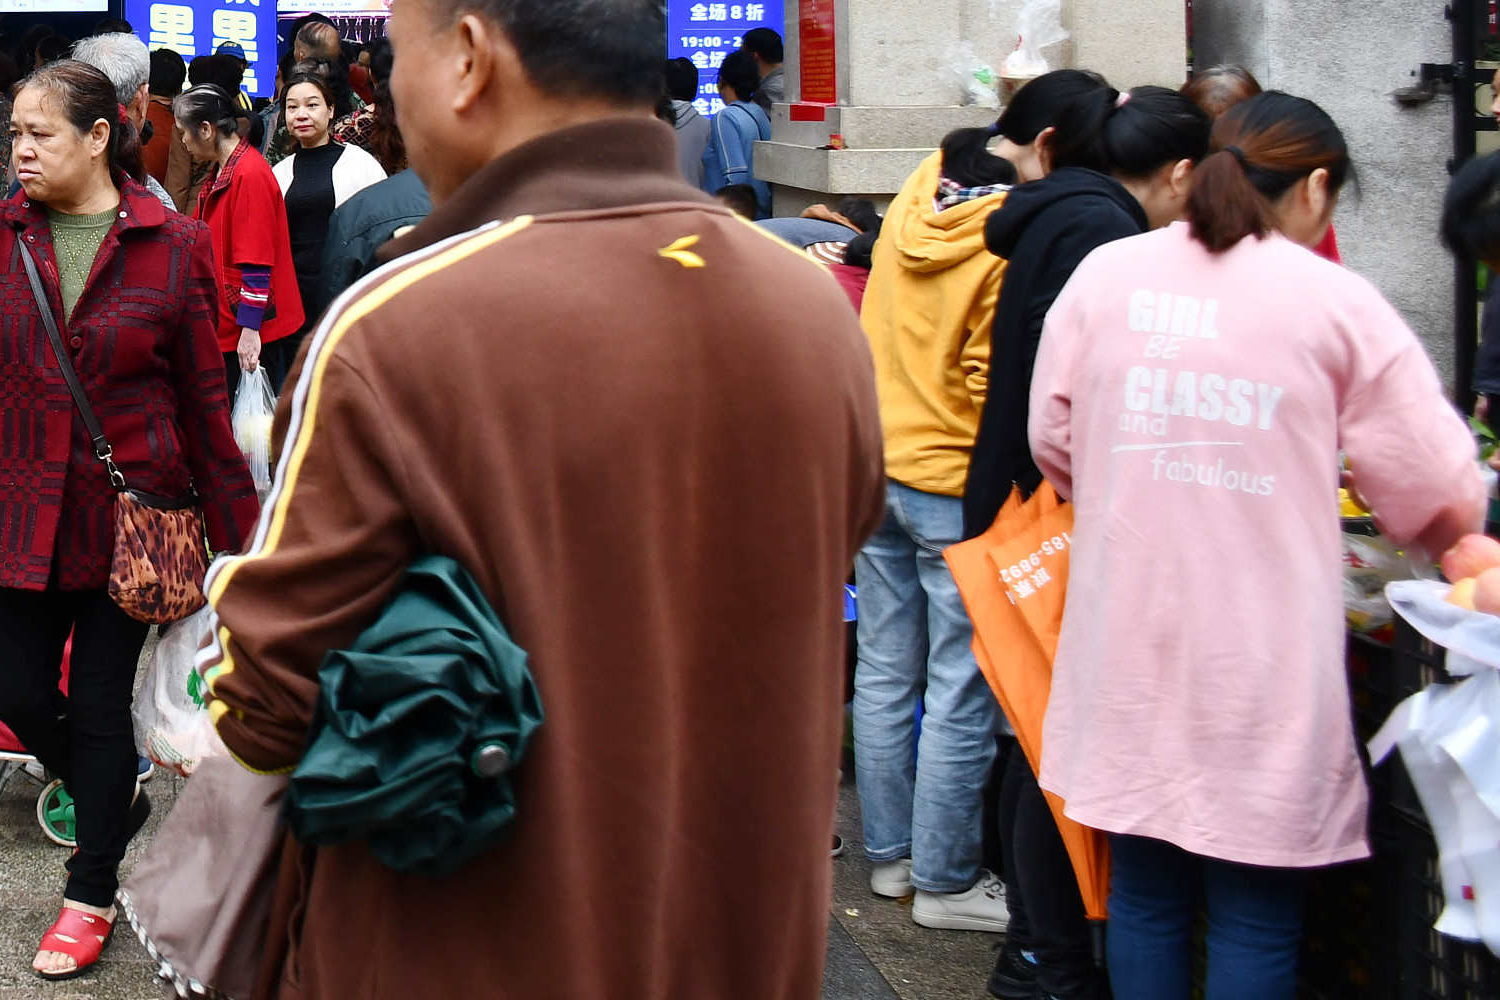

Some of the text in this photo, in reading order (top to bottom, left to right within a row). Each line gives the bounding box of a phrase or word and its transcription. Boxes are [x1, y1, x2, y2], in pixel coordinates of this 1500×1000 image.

[1128, 290, 1219, 340] GIRL
[1143, 334, 1185, 359] BE
[1125, 366, 1284, 430] CLASSY
[1118, 410, 1167, 437] and
[1152, 450, 1276, 497] fabulous
